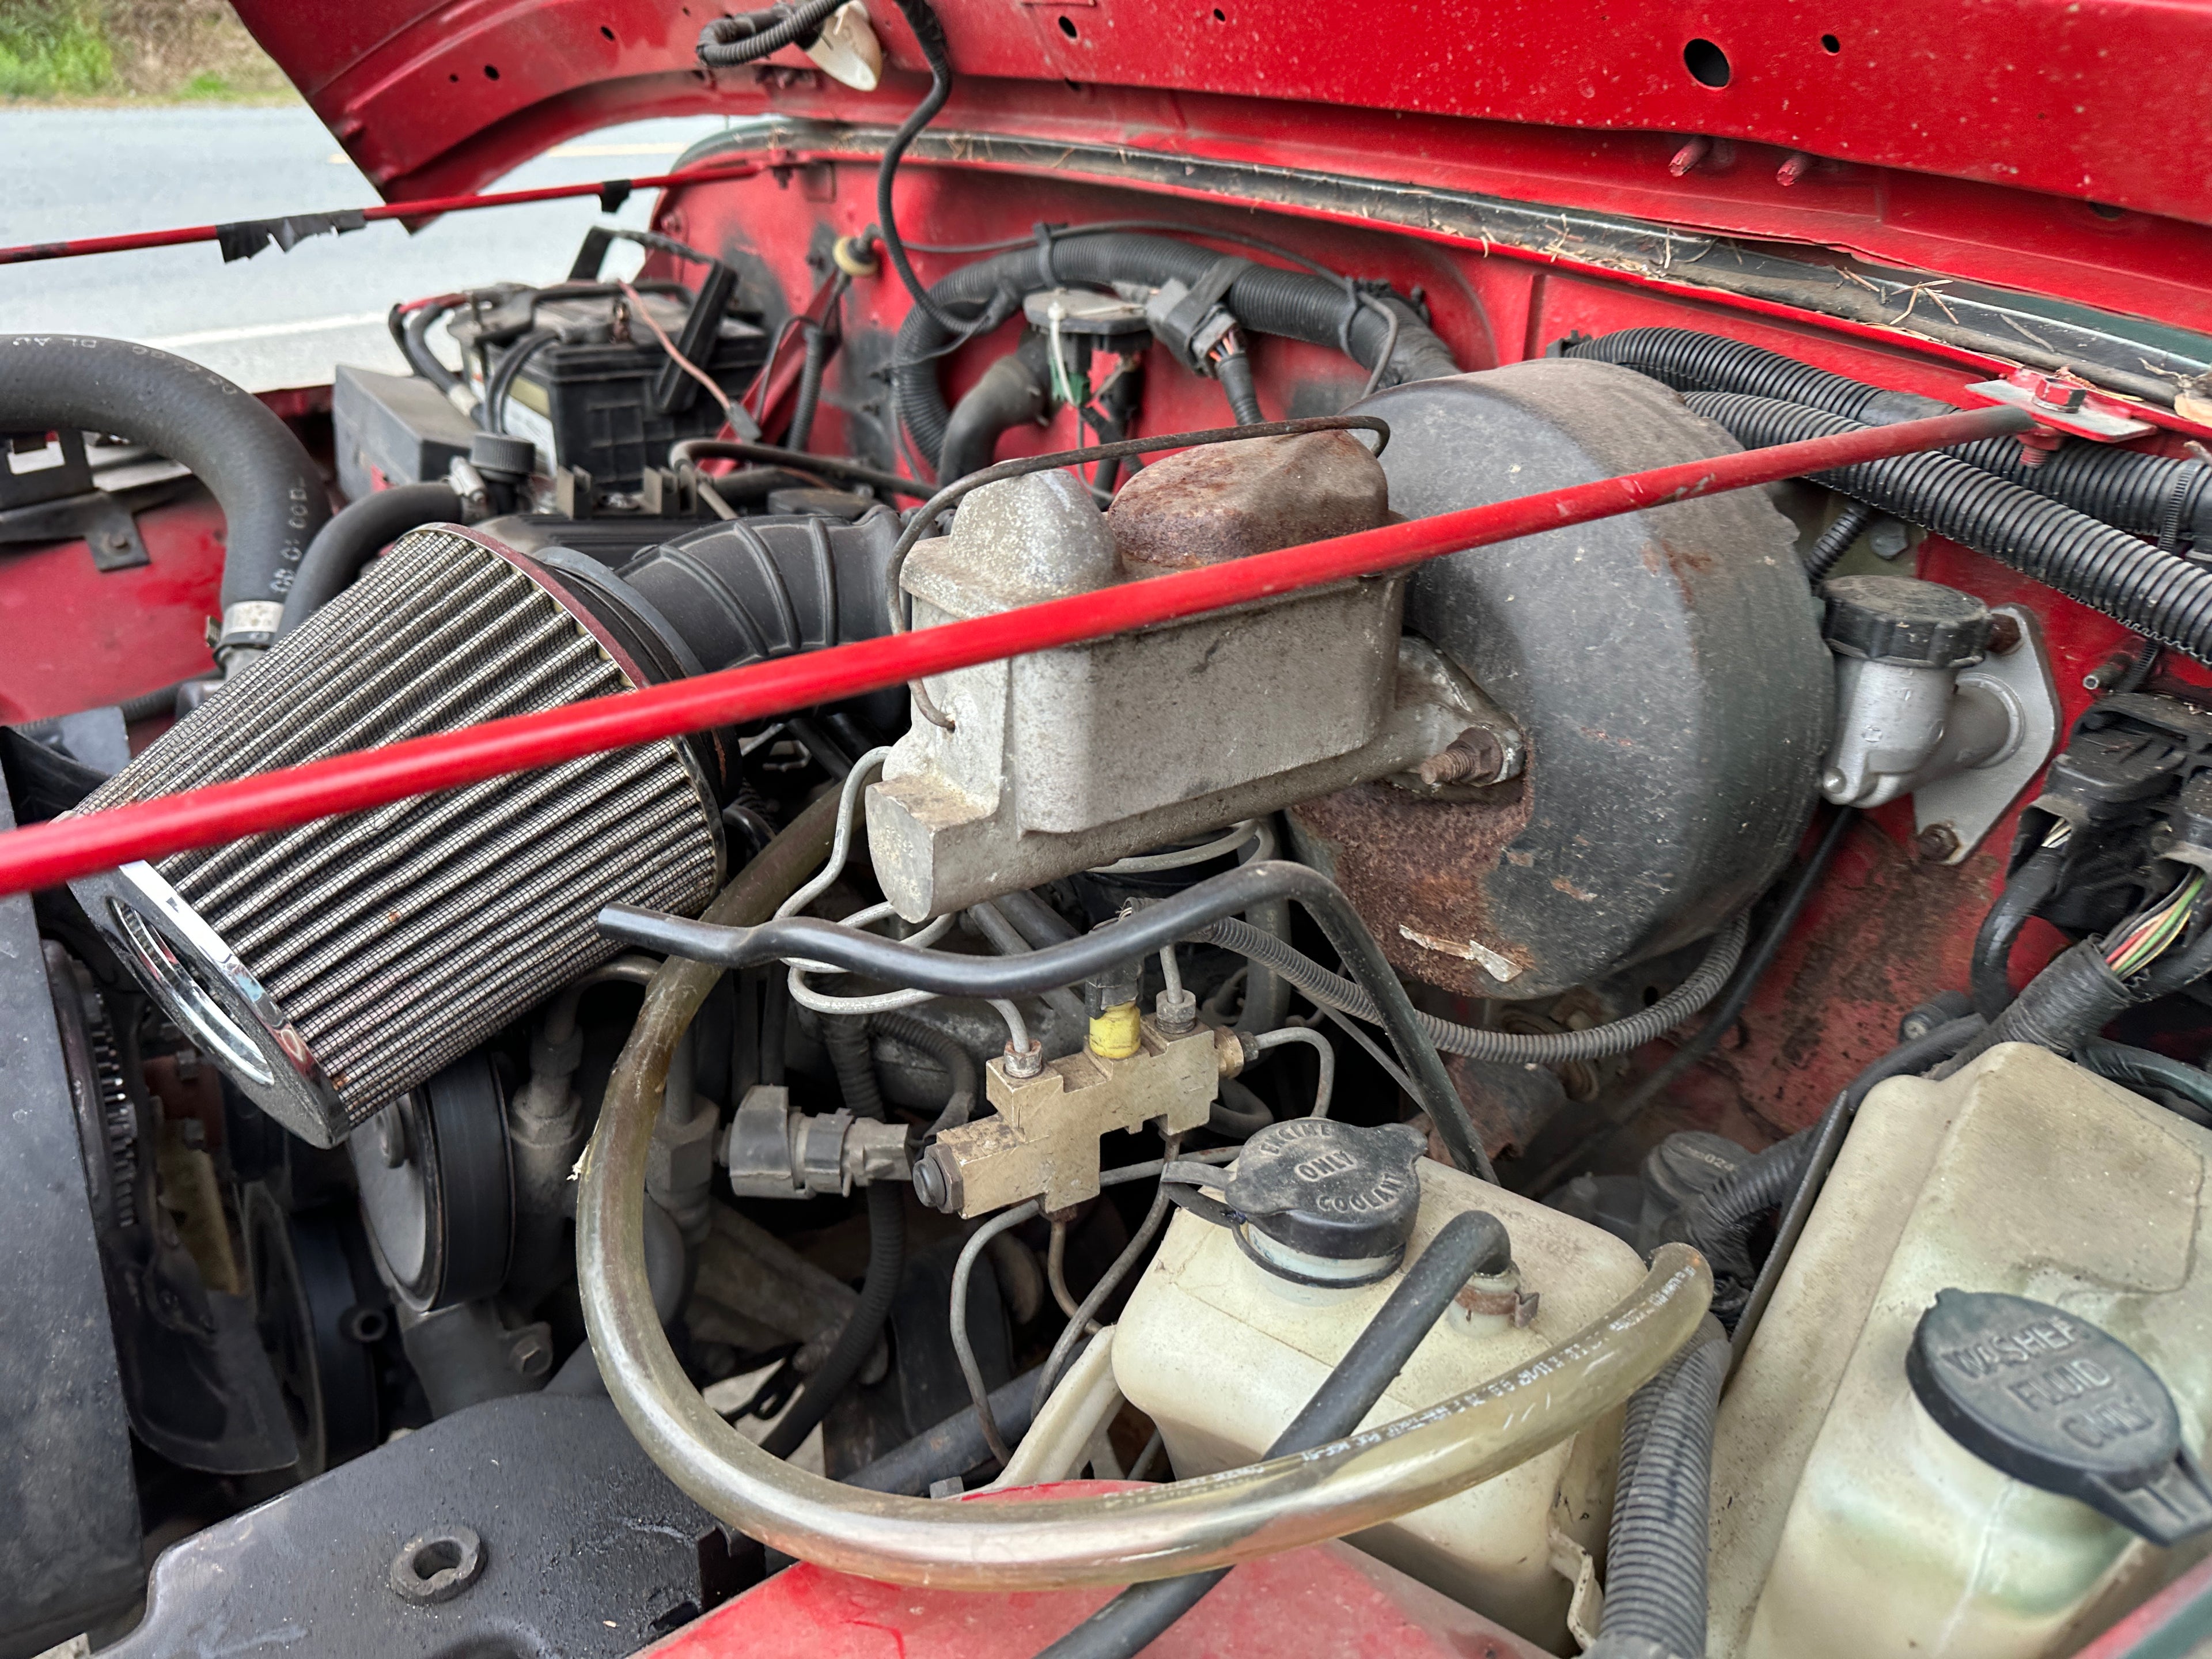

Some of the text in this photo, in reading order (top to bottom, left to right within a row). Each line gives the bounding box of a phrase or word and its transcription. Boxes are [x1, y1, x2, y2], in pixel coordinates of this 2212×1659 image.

[1260, 1123, 1332, 1155] ENGINE
[1296, 1151, 1355, 1181] ONLY
[1317, 1173, 1402, 1212] COOLANT
[1941, 1316, 2089, 1380] WASHER
[2008, 1358, 2112, 1412] FLUID
[2061, 1396, 2155, 1449] ONLY
